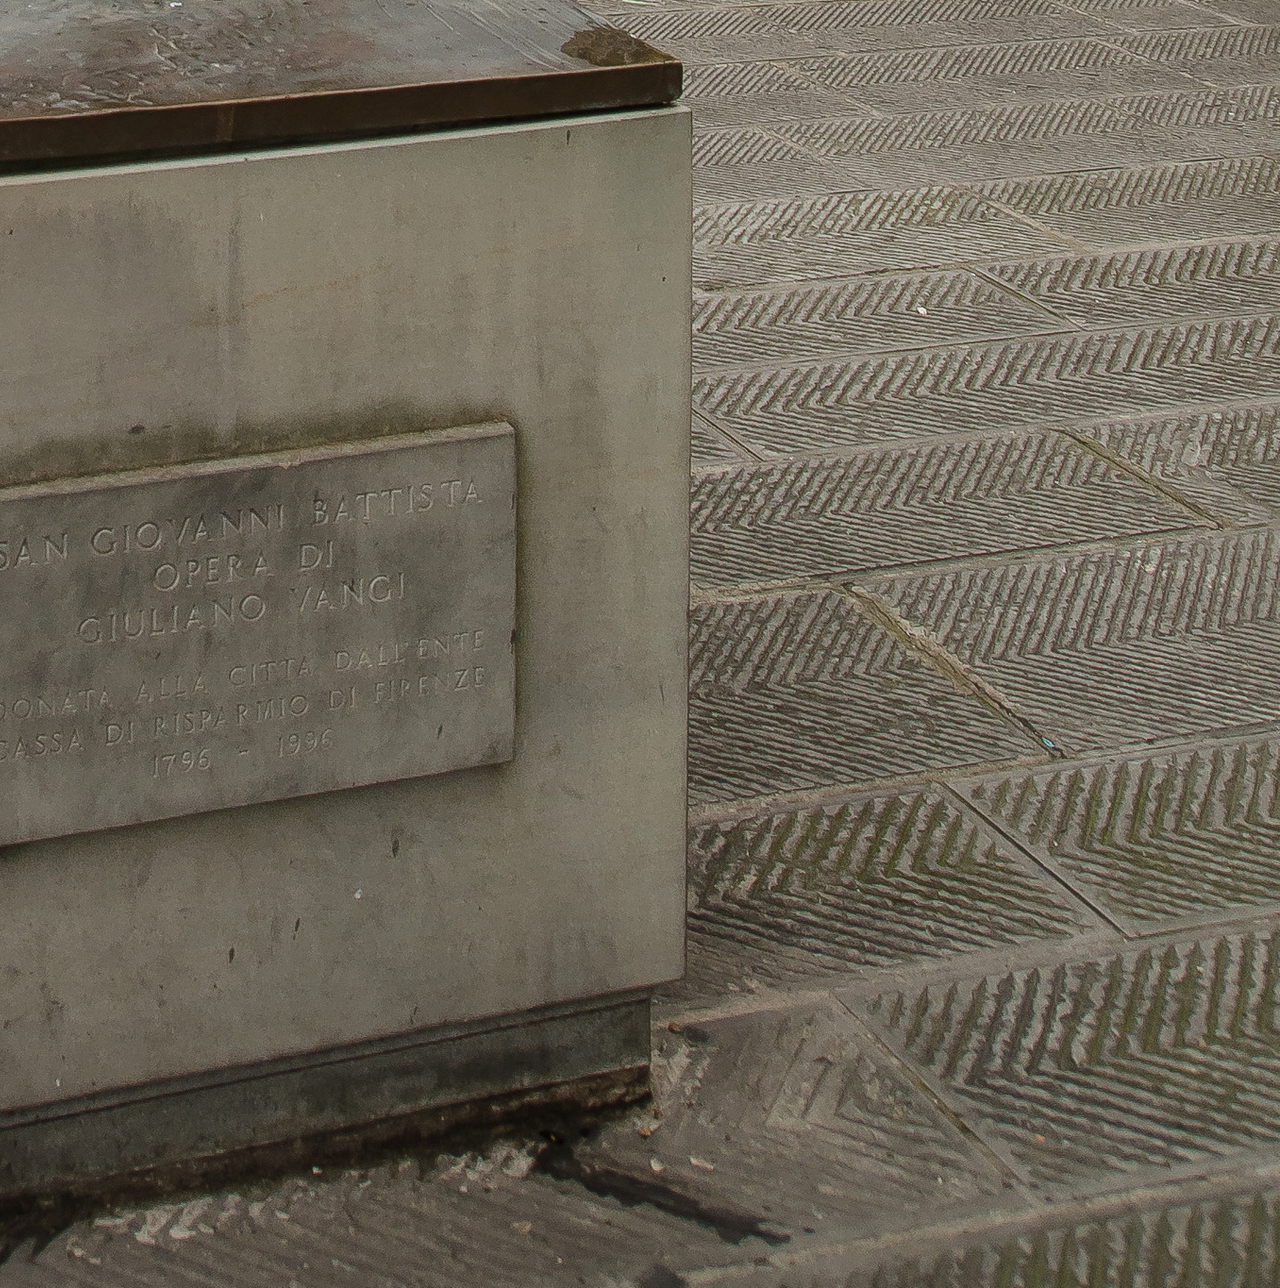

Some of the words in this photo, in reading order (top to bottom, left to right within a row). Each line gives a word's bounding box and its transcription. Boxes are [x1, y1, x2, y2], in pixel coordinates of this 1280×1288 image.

[90, 503, 285, 557] GIOVANNI
[312, 479, 483, 525] BATTISTA
[152, 549, 274, 592] OPERA
[298, 539, 334, 572] DI
[77, 594, 266, 644] GIULIANO
[290, 572, 406, 613] VANGI
[135, 672, 209, 704] ALLA
[334, 628, 485, 672] DALL'ENTE
[105, 720, 136, 748] DI
[153, 694, 310, 737] RISPARMIO
[328, 685, 357, 712] DI
[373, 665, 485, 705] FIRENZE
[152, 747, 213, 780] 1796
[277, 727, 335, 759] 1996
